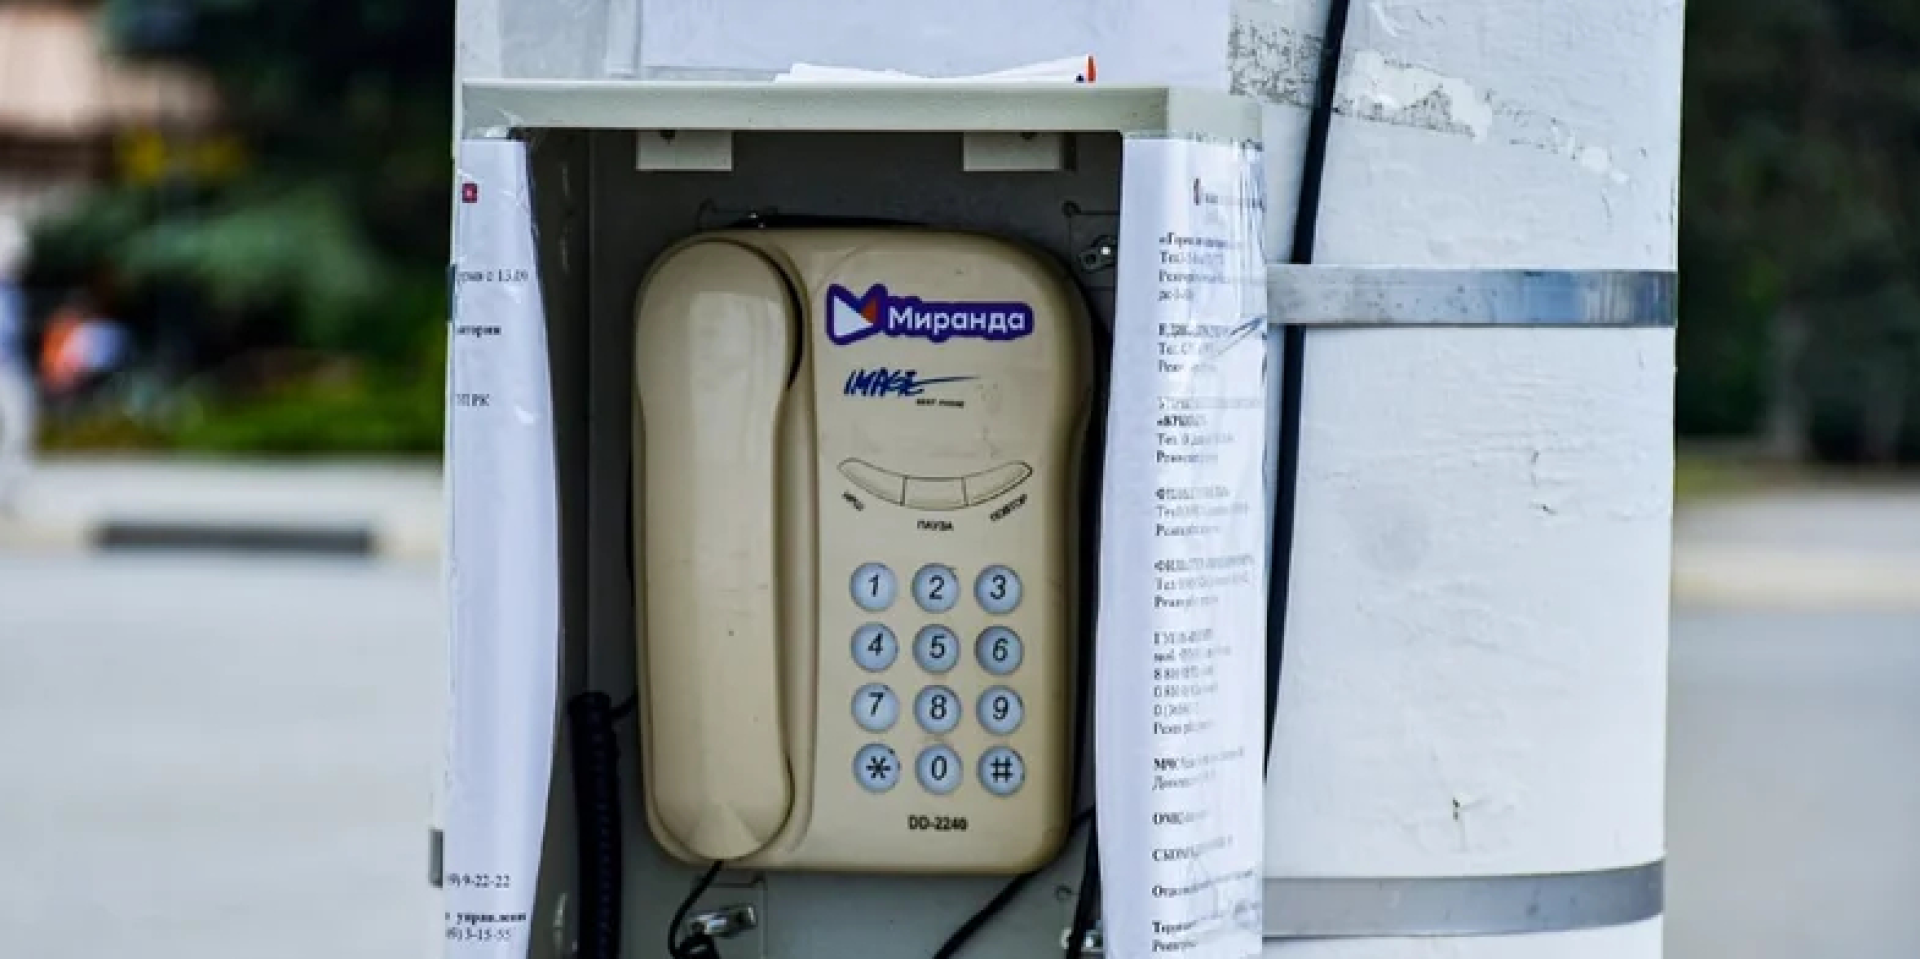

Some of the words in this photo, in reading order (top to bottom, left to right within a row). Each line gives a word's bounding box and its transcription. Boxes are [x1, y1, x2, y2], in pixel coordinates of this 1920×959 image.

[888, 305, 1025, 335] Миранда
[844, 366, 979, 396] IMAGE
[989, 493, 1028, 521] ПОВТОР
[916, 519, 954, 532] ПАУЗА
[868, 574, 880, 598] 1
[929, 575, 946, 600] 2
[990, 574, 1007, 600] 3
[868, 633, 884, 656] 4
[929, 634, 946, 659] 5
[992, 638, 1009, 662] 6
[868, 691, 884, 717] 7
[929, 694, 947, 720] 8
[992, 696, 1009, 721] 9
[931, 755, 947, 781] 0
[908, 815, 969, 831] DD-2240
